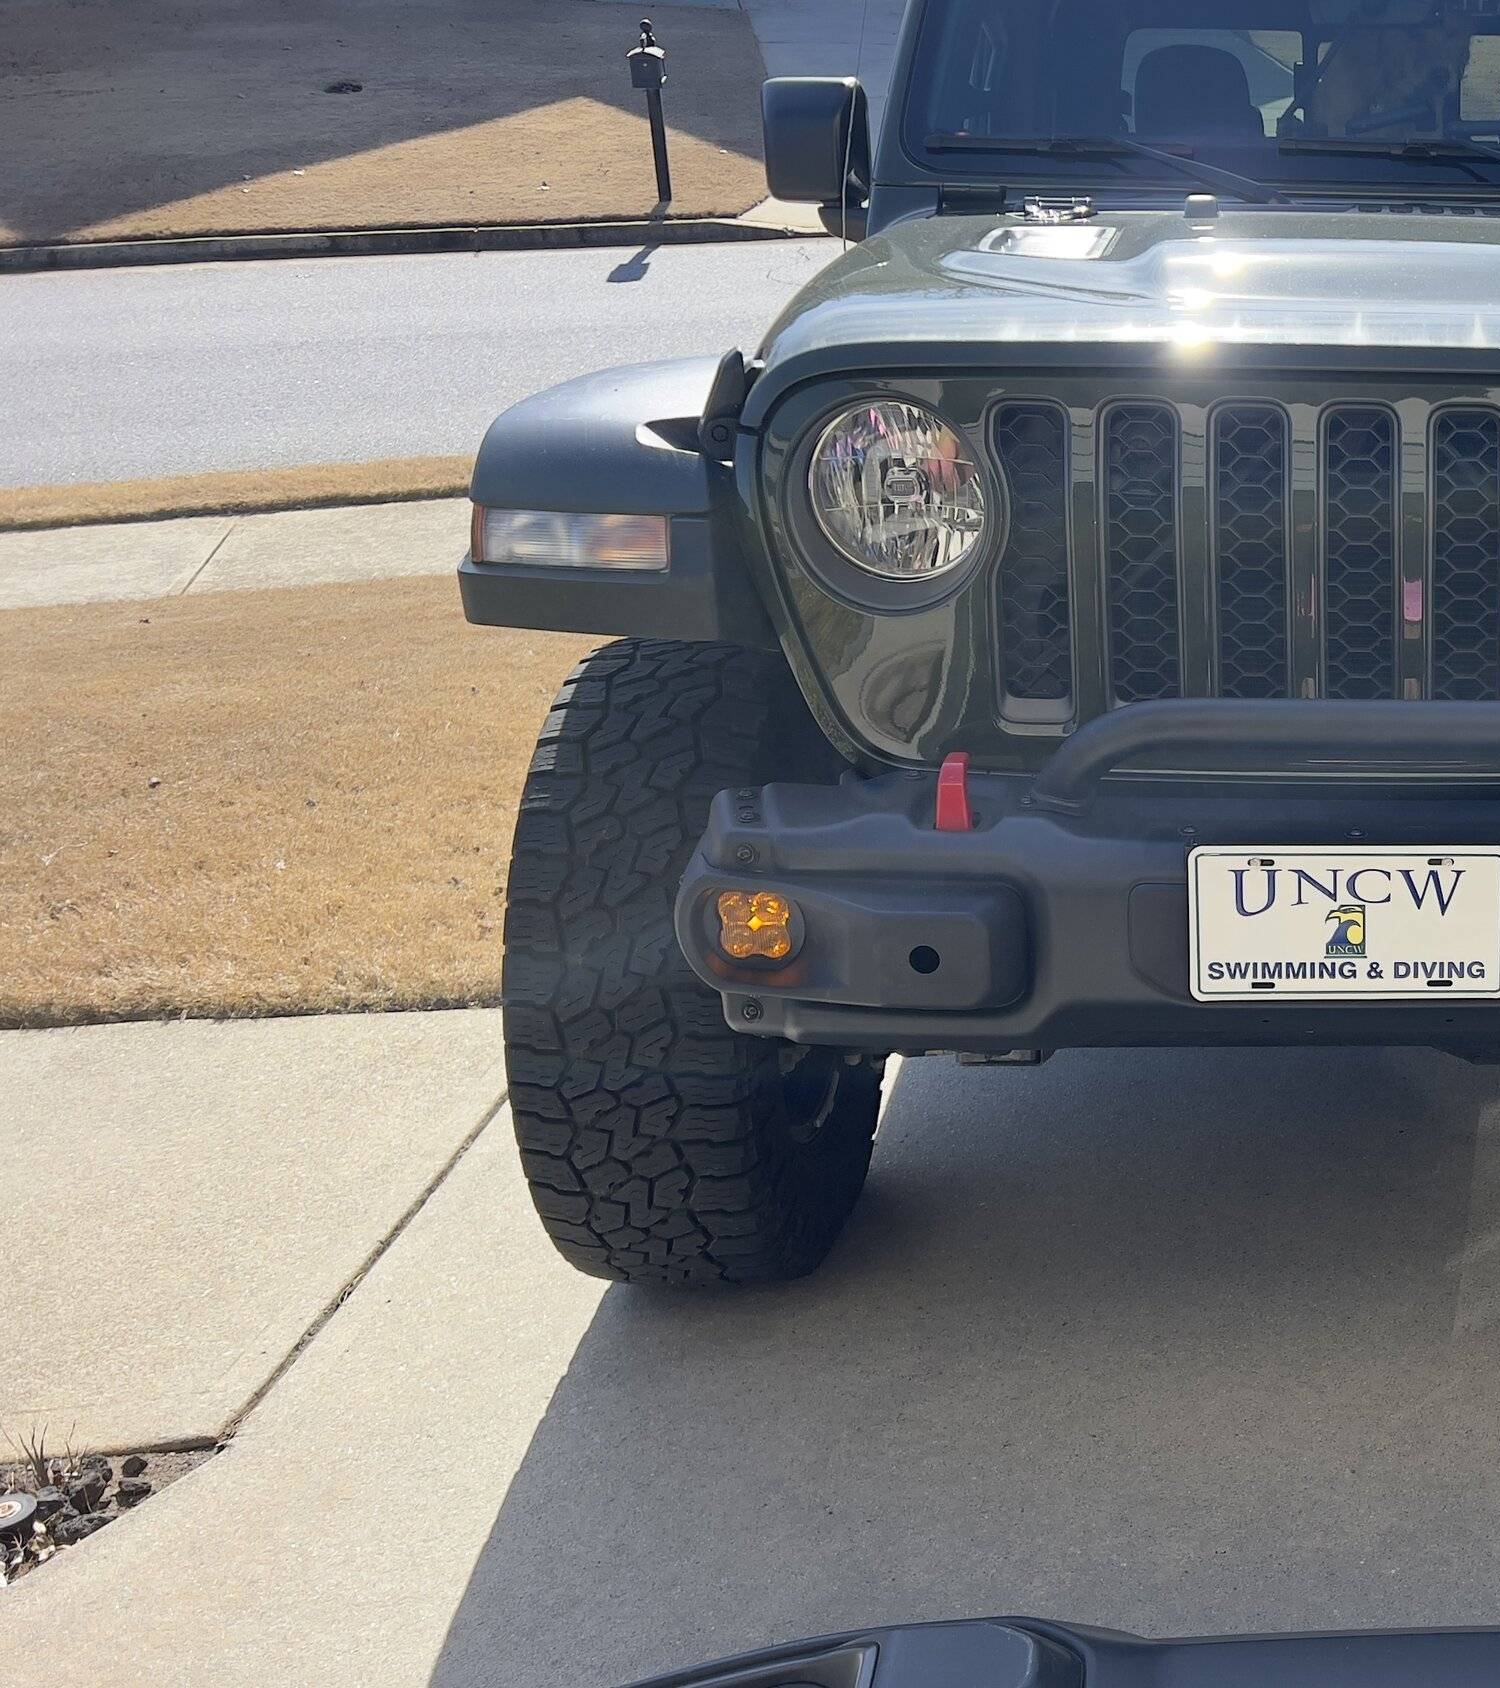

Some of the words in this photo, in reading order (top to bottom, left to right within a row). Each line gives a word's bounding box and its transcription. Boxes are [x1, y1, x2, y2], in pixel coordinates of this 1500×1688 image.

[1228, 868, 1467, 917] UNCW
[1327, 945, 1366, 954] UNCW
[1207, 961, 1357, 980] SWIMMING
[1366, 961, 1384, 979] &
[1393, 961, 1486, 979] DIVING
